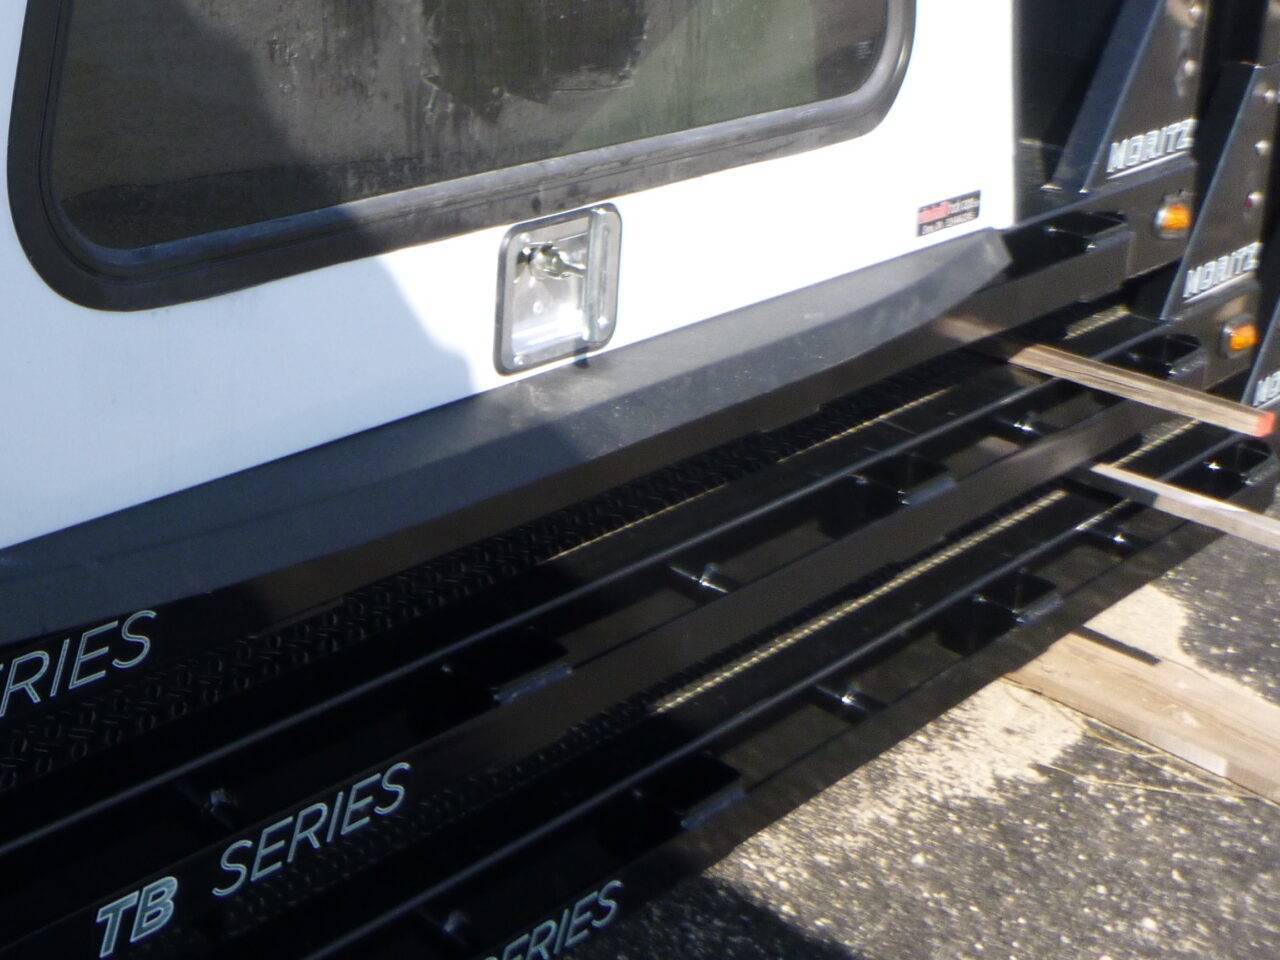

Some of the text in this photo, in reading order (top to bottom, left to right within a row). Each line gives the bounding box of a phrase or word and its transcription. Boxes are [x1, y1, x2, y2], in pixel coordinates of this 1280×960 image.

[1106, 117, 1197, 172] MORITZ
[1183, 241, 1264, 297] MORITZ
[96, 761, 411, 958] TB SERIES
[484, 880, 623, 960] ERIES
